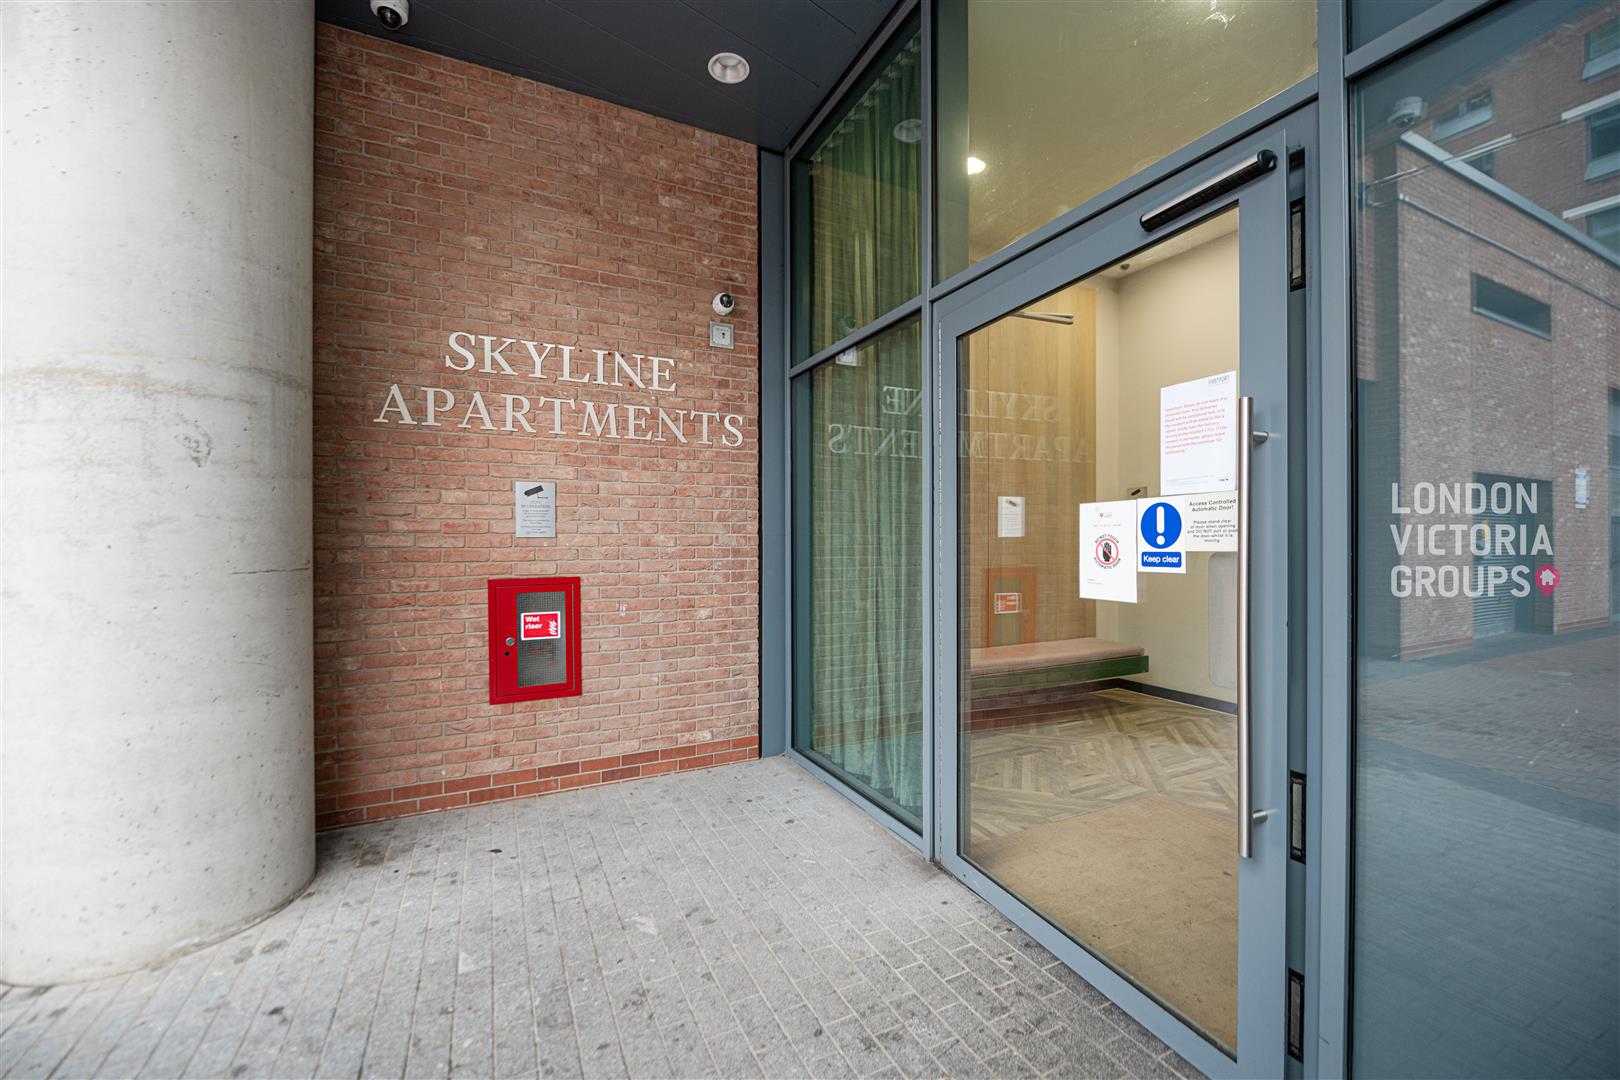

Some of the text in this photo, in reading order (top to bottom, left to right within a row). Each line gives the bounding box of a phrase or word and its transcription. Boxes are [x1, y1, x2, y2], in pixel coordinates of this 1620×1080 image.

[445, 331, 677, 392] SKYLINE
[373, 383, 744, 447] APARTMENTS
[1144, 555, 1160, 564] Keep
